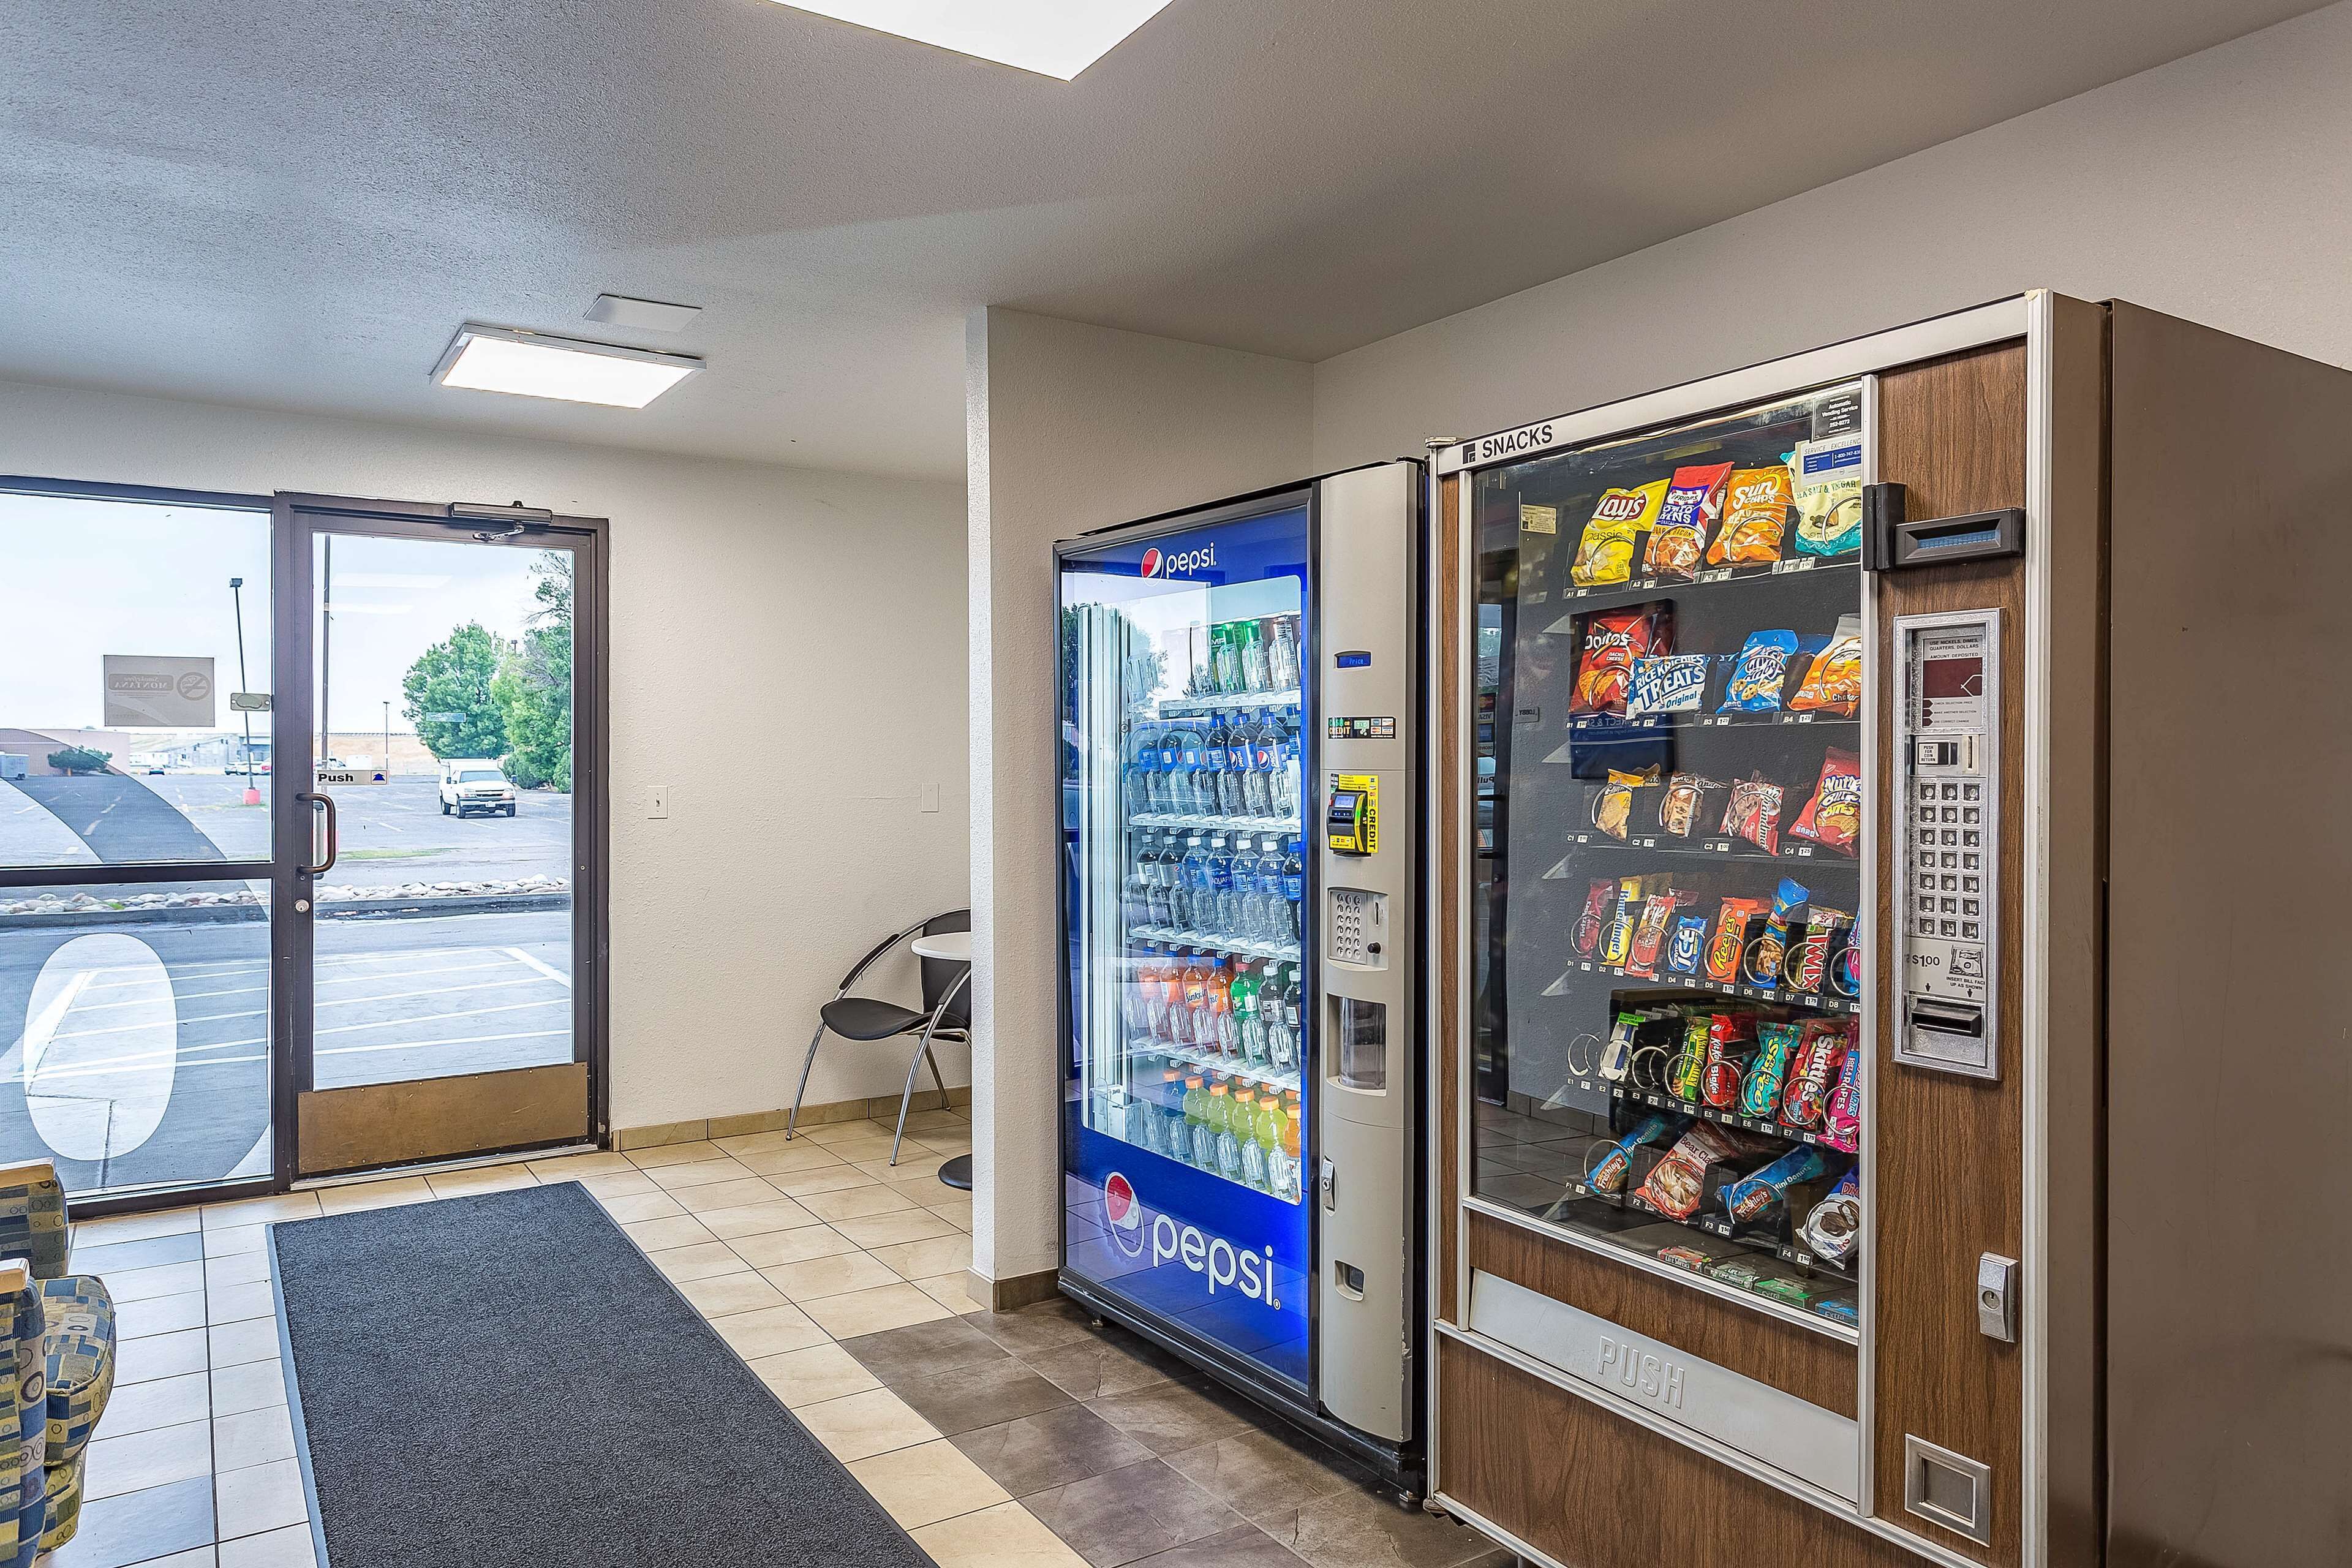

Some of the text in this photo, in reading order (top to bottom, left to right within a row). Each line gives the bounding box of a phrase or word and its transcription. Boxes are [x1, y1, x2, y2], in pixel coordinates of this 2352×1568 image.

[1822, 409, 1841, 418] Vending
[1828, 400, 1852, 410] Automatic
[1482, 424, 1553, 458] SNACKS
[1804, 438, 1861, 454] SERVICE EXCELLENC
[1744, 494, 1775, 503] CHIPS
[1797, 480, 1856, 499] SEA SALT & VINEGAR
[1592, 497, 1645, 521] Lay's
[1167, 542, 1214, 579] pepsi
[1635, 655, 1704, 690] RICE KRISPIES
[1638, 667, 1706, 710] TREATS
[1666, 691, 1697, 708] Original
[1969, 903, 1977, 912] 12
[1611, 890, 1629, 954] Butterfinger
[1946, 924, 1977, 935] 13 14
[1803, 929, 1831, 993] TWIX
[1912, 955, 1940, 967] $1.00
[1801, 1035, 1834, 1102] Skittles
[1837, 1076, 1851, 1110] ROPES
[1637, 1123, 1657, 1144] Donuts
[1680, 1136, 1699, 1154] Bear
[1597, 1157, 1623, 1189] Freshley's
[1787, 1165, 1812, 1183] Donuts
[1737, 1191, 1768, 1217] Freshley's
[1153, 1213, 1273, 1306] pepsi
[1598, 1335, 1686, 1409] PUSH
